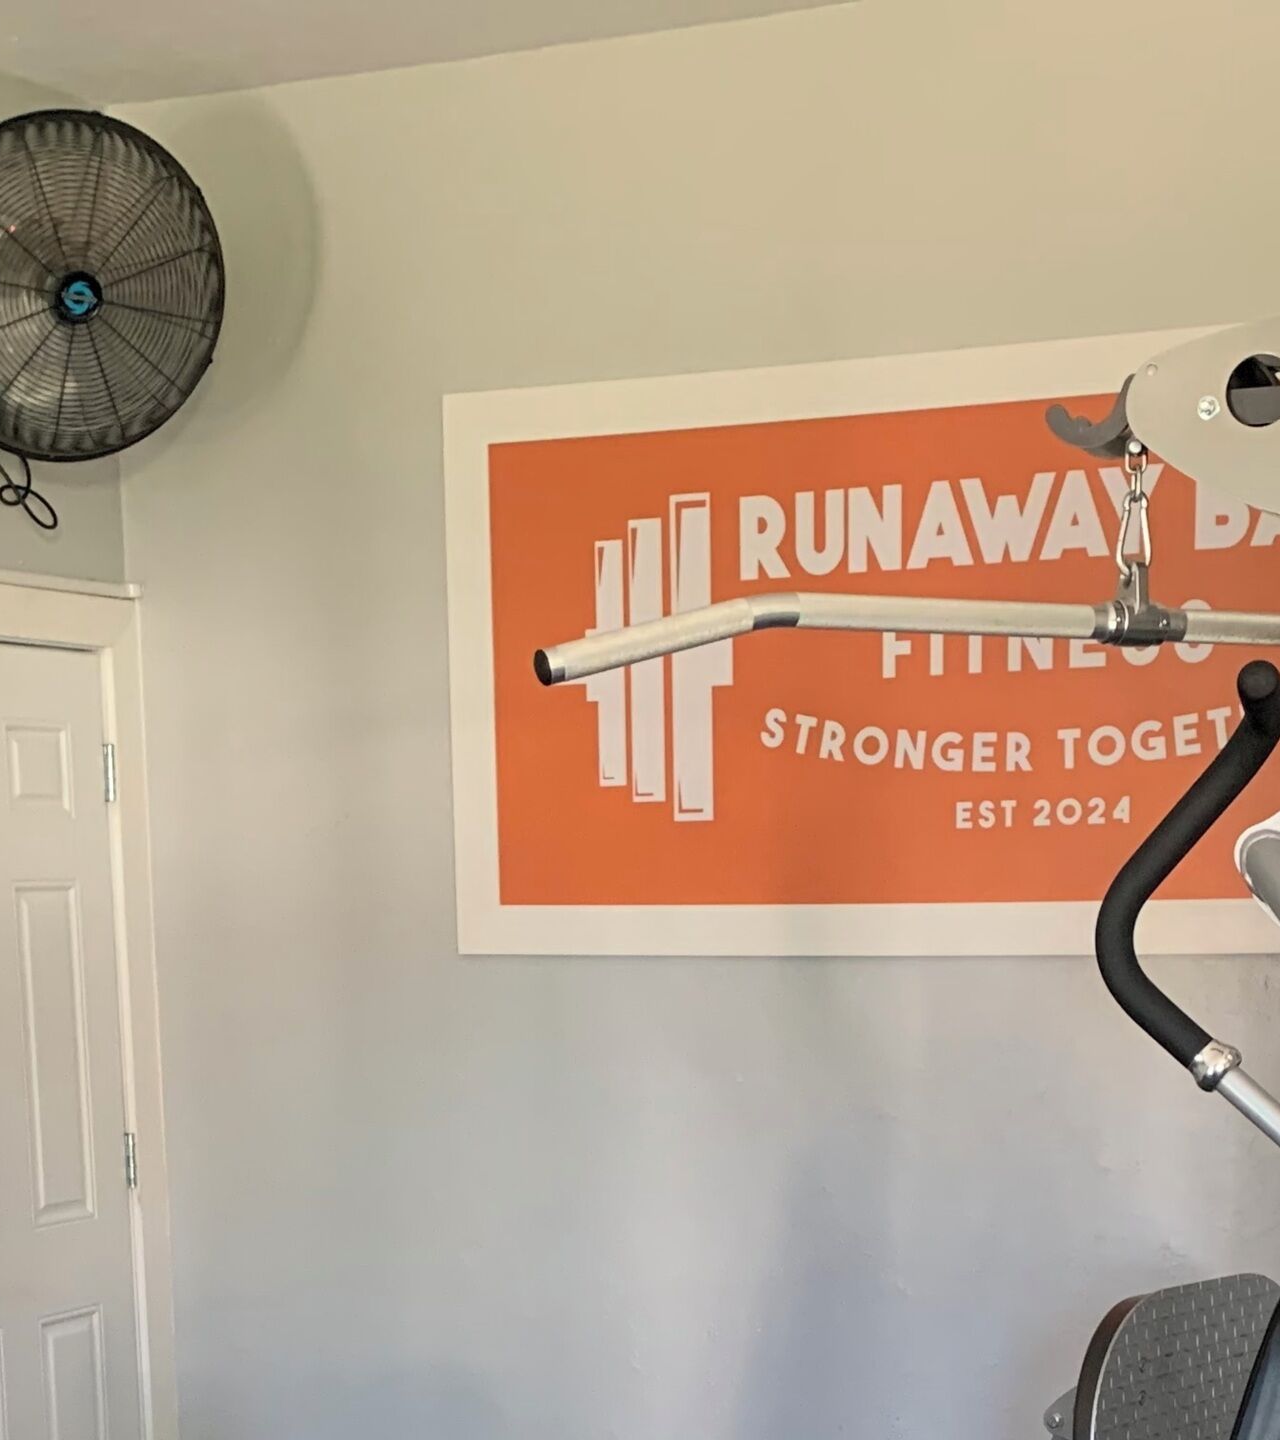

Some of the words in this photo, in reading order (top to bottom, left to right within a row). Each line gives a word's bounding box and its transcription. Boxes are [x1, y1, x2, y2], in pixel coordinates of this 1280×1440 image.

[739, 463, 1165, 581] RUNAWAY
[761, 708, 1033, 773] STRONGER
[955, 799, 1018, 829] EST
[1033, 795, 1131, 827] 2024
